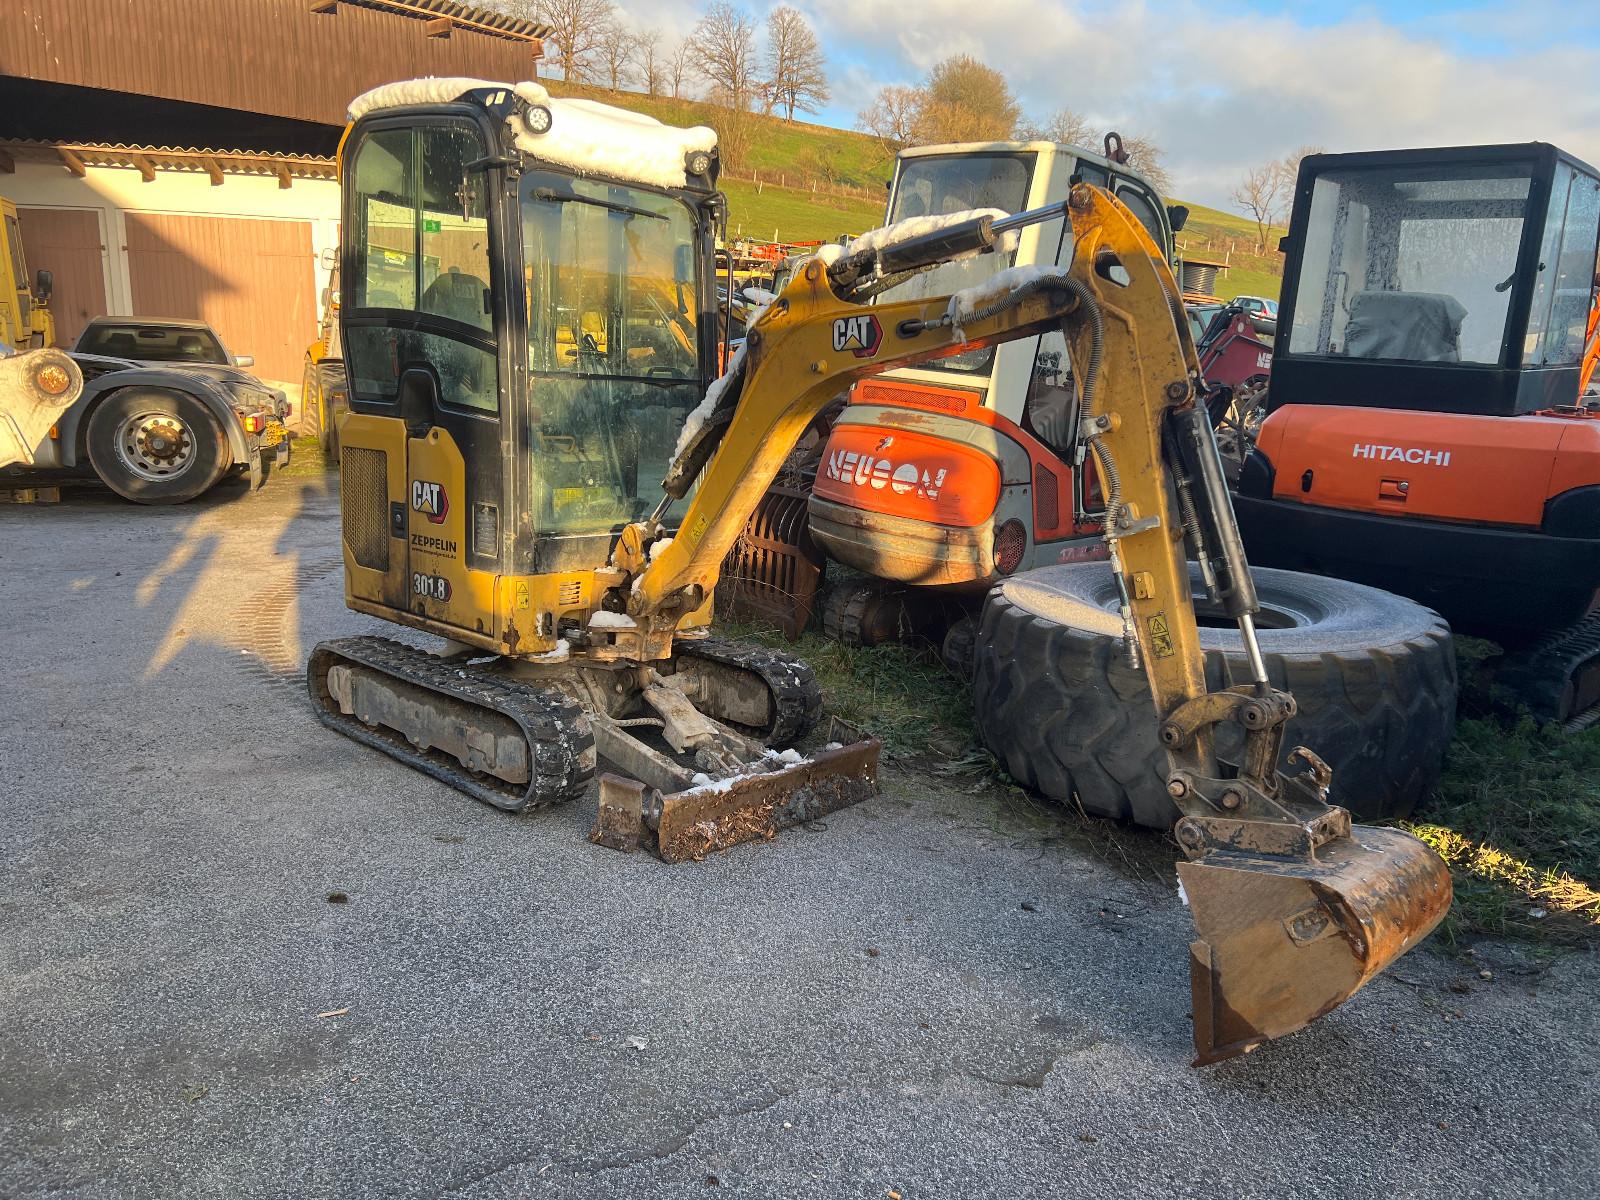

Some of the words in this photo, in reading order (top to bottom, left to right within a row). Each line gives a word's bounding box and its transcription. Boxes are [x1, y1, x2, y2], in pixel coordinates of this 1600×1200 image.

[833, 315, 871, 351] CAT
[1352, 443, 1451, 467] HITACHI
[826, 448, 947, 501] NEUSON
[412, 480, 440, 515] CAT
[411, 533, 457, 553] ZEPPELIN
[413, 573, 445, 600] 301.8
